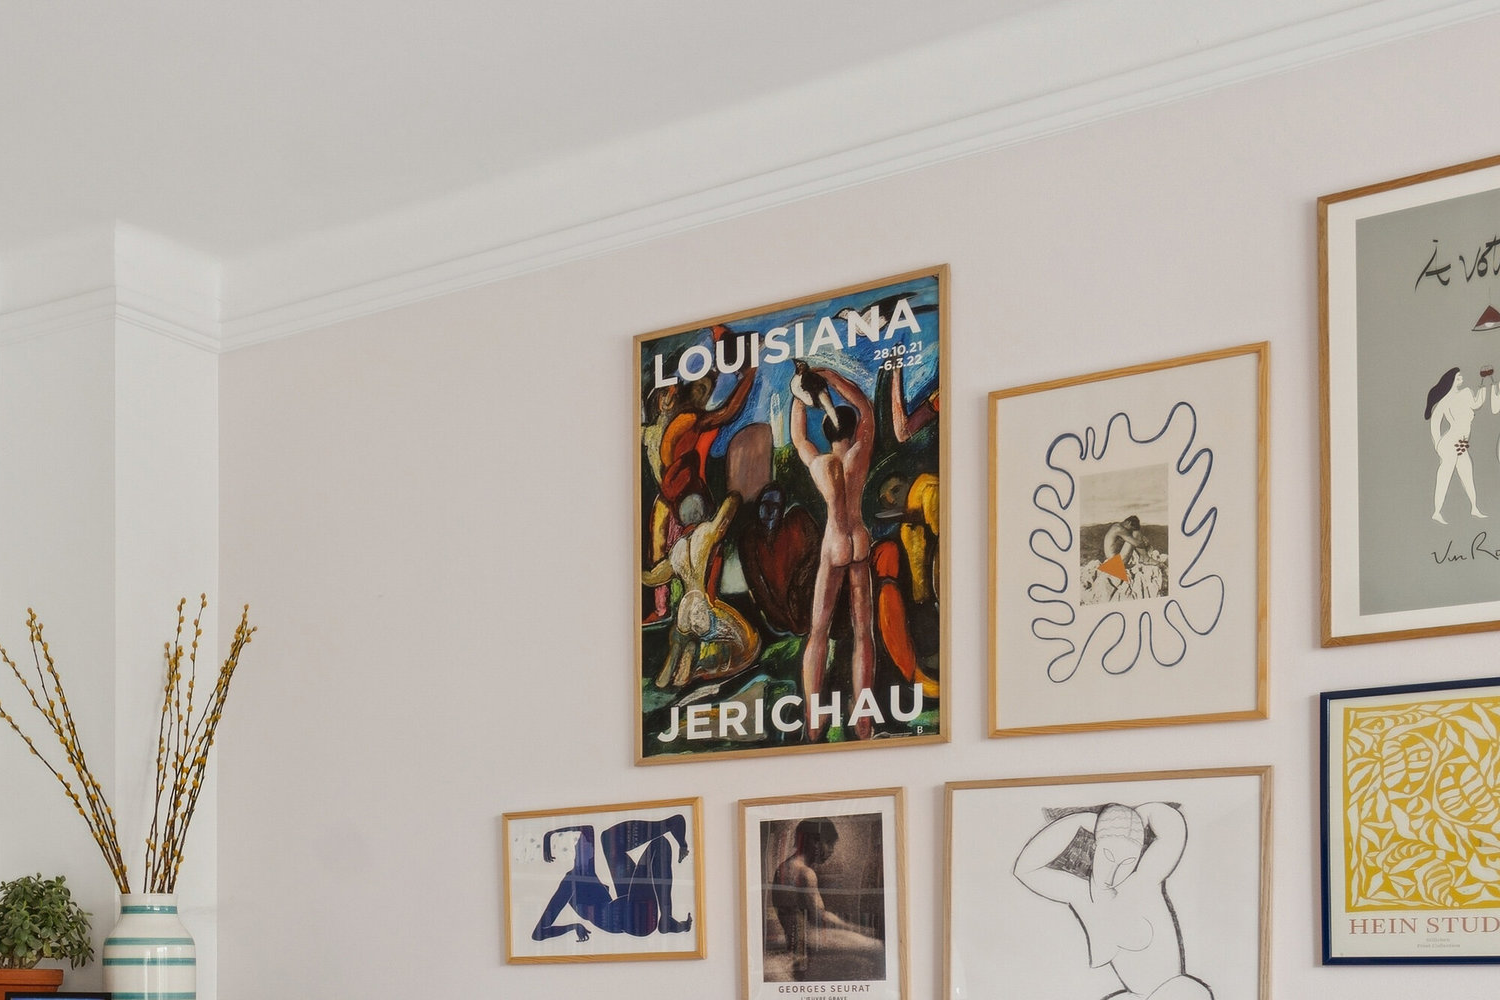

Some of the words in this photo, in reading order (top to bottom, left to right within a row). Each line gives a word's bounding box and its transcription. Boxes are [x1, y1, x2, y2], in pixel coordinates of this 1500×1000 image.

[654, 298, 923, 390] LOUISIANA
[873, 341, 923, 362] 28.10.21
[1431, 540, 1467, 565] Vin
[656, 682, 925, 744] JERICHAU
[1349, 917, 1417, 935] HEIN
[778, 985, 826, 993] GEORGES
[831, 984, 871, 993] SEURAT
